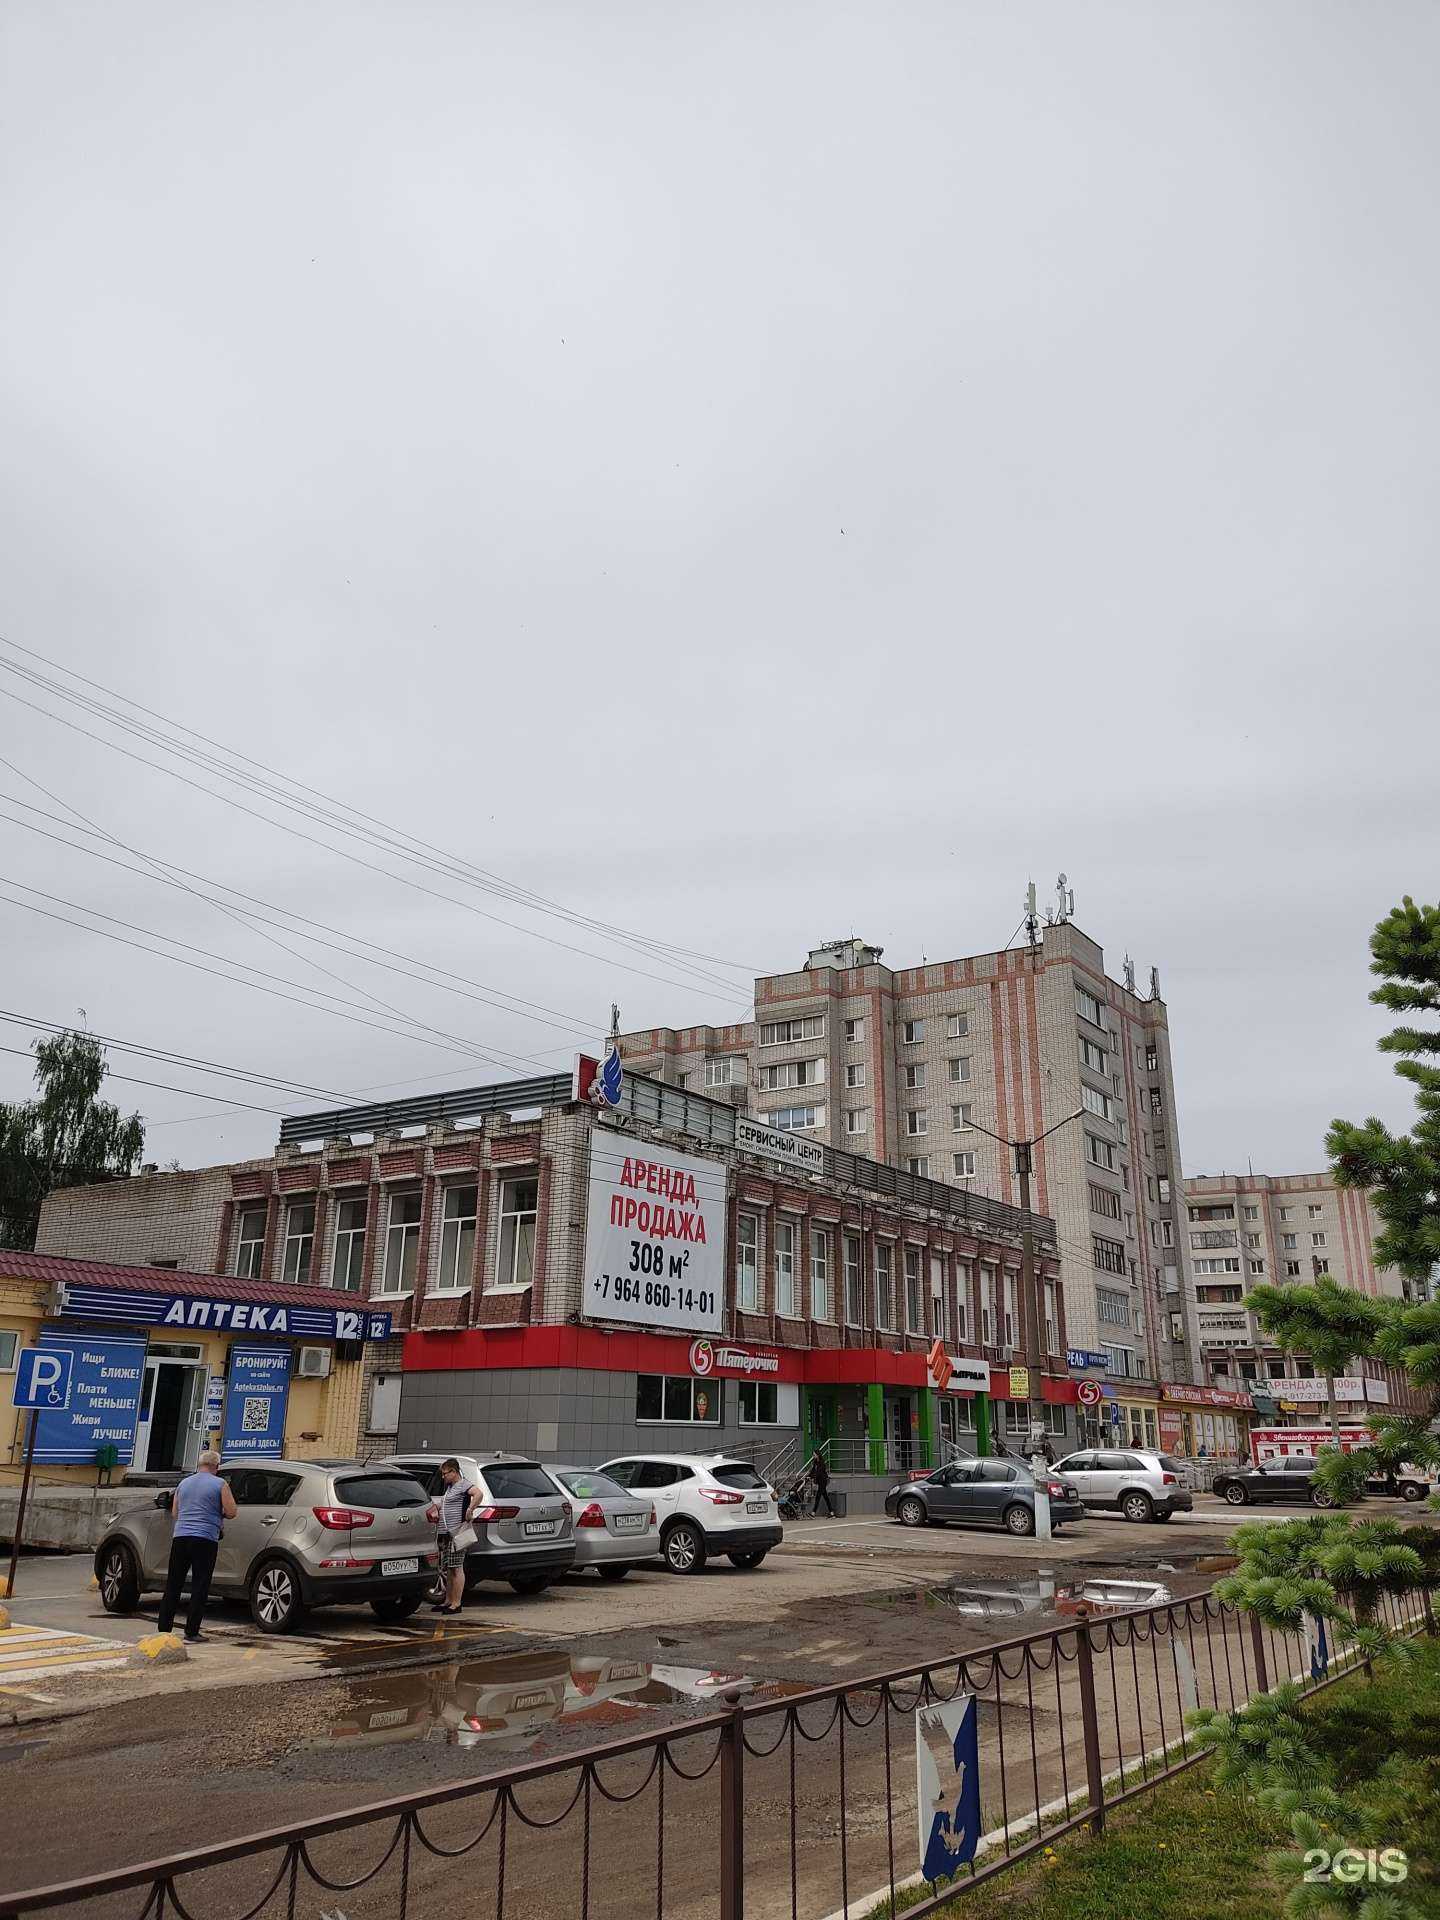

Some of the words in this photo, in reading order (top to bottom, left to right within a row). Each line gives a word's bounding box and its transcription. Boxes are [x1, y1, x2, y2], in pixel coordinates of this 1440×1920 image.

[739, 1124, 795, 1154] СЕРВИСНЫЙ
[797, 1143, 822, 1163] ЦЕНТР
[620, 1157, 700, 1209] АРЕНДА,
[610, 1194, 706, 1244] ПРОДАЖА
[629, 1240, 664, 1276] 308
[593, 1274, 610, 1299] +7
[614, 1276, 641, 1304] 964
[645, 1281, 714, 1314] 860-14-01
[164, 1299, 288, 1332] АПТЕКА
[335, 1311, 359, 1339] 12
[370, 1321, 383, 1338] 12
[82, 1352, 106, 1365] Ищи
[235, 1356, 287, 1370] БРОНИРУЙ!
[715, 1347, 779, 1374] Пятерочка
[28, 1355, 62, 1401] P
[100, 1367, 140, 1380] БЛИЖЕ!
[77, 1382, 108, 1394] Плати
[89, 1397, 136, 1410] МЕНЬШЕ!
[71, 1413, 101, 1425] Живи
[91, 1428, 132, 1440] ЛУЧШЕ!
[226, 1438, 256, 1448] ЗАБИРАЙ
[257, 1439, 280, 1449] ЗДЕСЬ!
